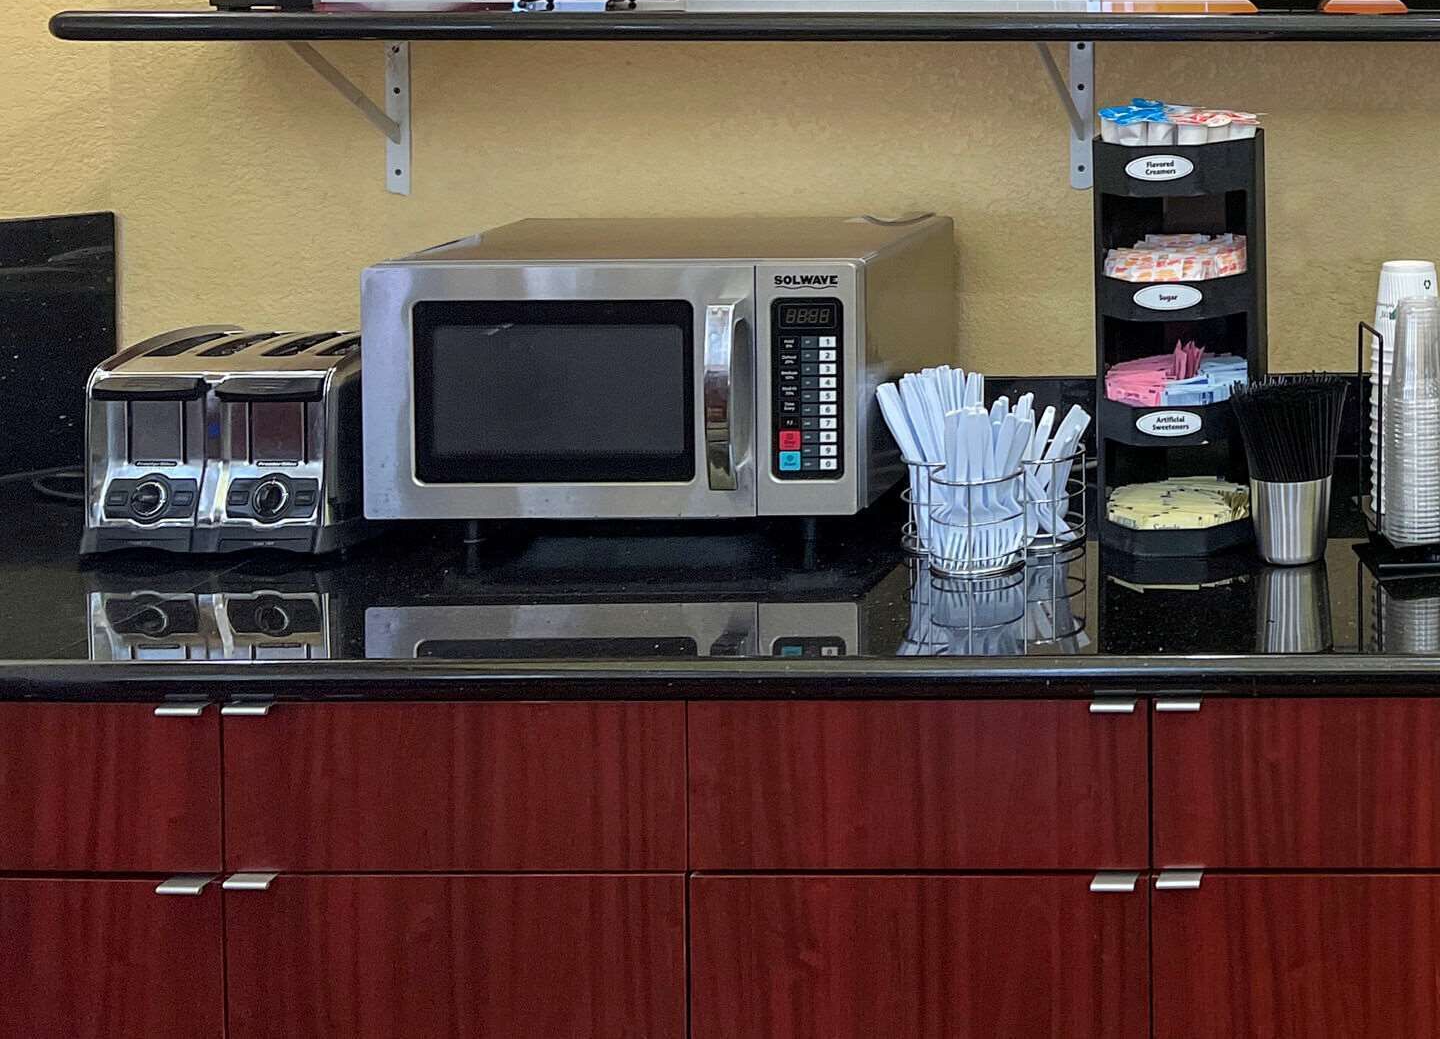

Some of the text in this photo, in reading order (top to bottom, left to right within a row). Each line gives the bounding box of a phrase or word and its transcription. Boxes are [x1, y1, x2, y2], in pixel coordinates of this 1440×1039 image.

[1146, 160, 1175, 168] Flavored
[1145, 168, 1176, 176] Creamers
[774, 275, 838, 285] SOLWAVE
[1159, 294, 1178, 303] Sugar
